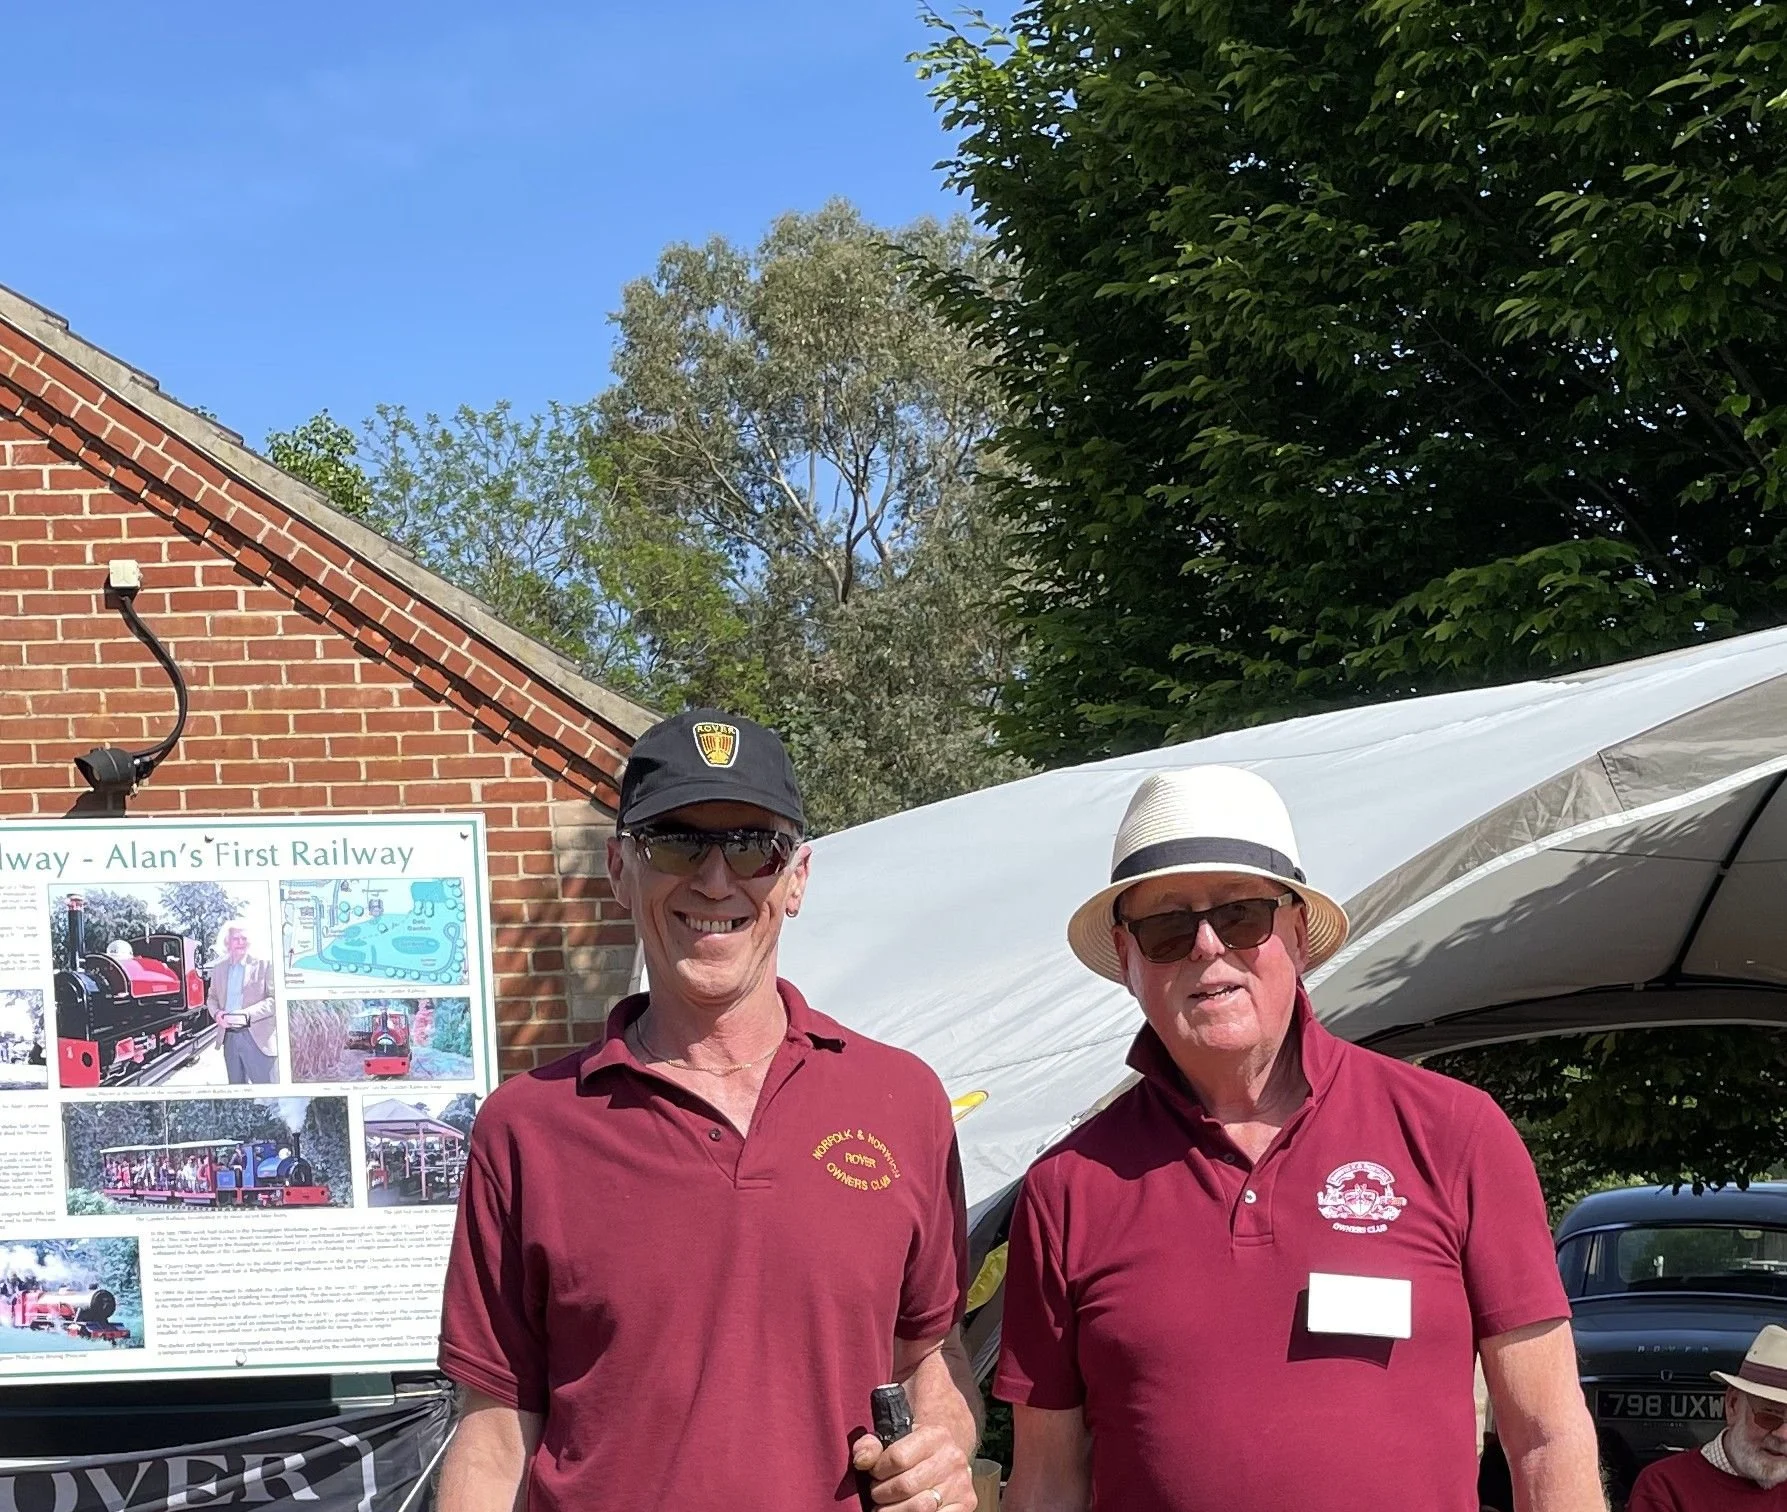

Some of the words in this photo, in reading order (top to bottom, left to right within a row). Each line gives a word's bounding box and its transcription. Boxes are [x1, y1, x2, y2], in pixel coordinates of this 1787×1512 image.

[697, 725, 736, 735] ROVER
[105, 840, 204, 870] Alan's
[215, 841, 280, 868] First
[291, 837, 415, 874] Railway
[812, 1128, 854, 1161] NORFOLK
[857, 1129, 865, 1141] &
[845, 1152, 877, 1169] ROVER
[826, 1162, 869, 1191] OWNERS
[870, 1174, 892, 1191] CLUB
[1608, 1393, 1662, 1417] 798
[1670, 1394, 1725, 1419] UXW
